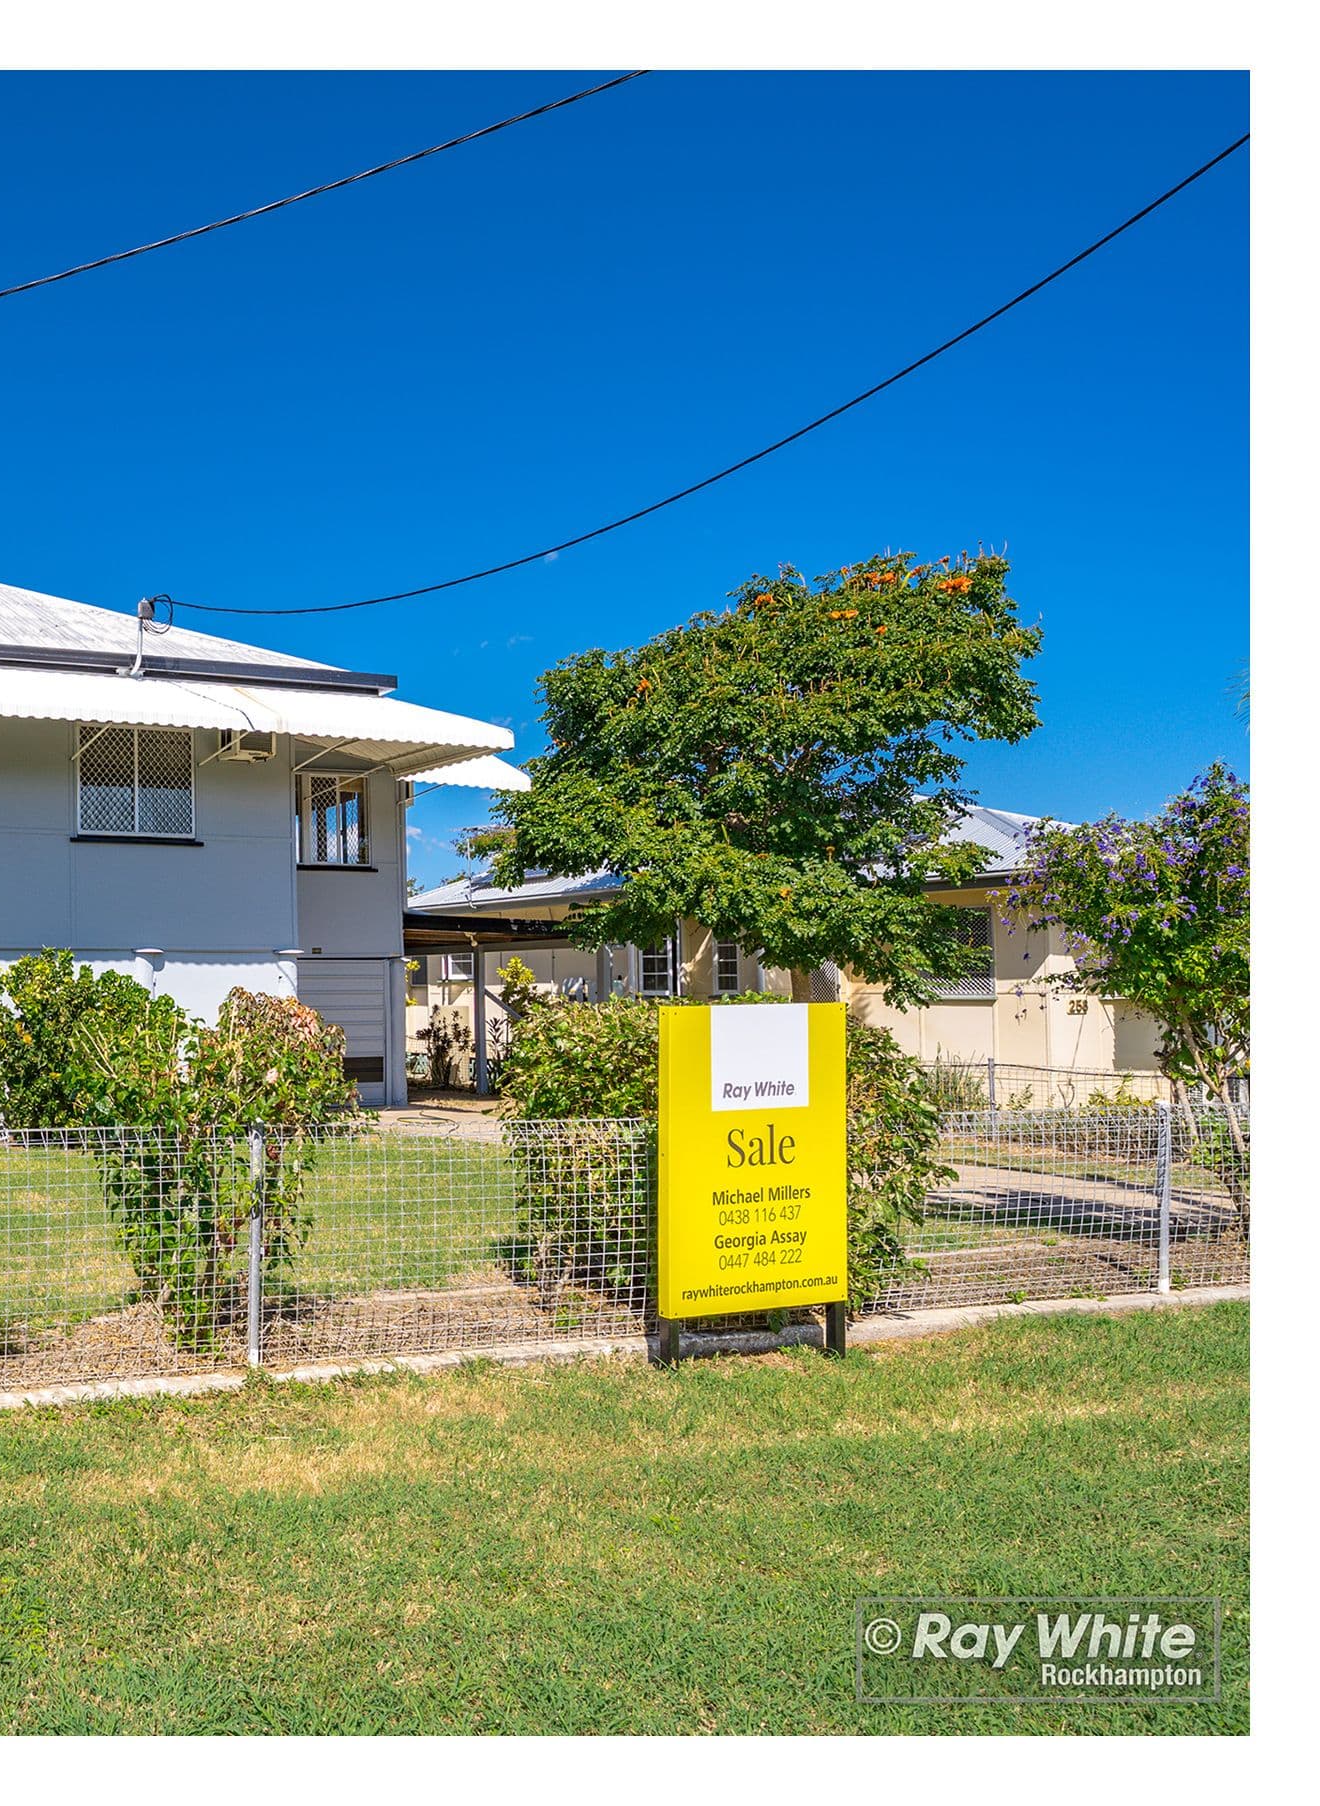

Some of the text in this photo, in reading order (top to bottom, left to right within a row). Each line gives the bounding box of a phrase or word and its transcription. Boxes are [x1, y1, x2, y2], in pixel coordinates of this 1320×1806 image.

[722, 1080, 795, 1101] Ray White
[727, 1123, 796, 1168] Sale
[712, 1185, 811, 1206] Michael Millers
[718, 1204, 801, 1226] 0438 116 437
[714, 1230, 807, 1250] Georgia Assay
[718, 1248, 802, 1271] 0447 484 222
[681, 1275, 838, 1302] raywhiterockhampton.com.au
